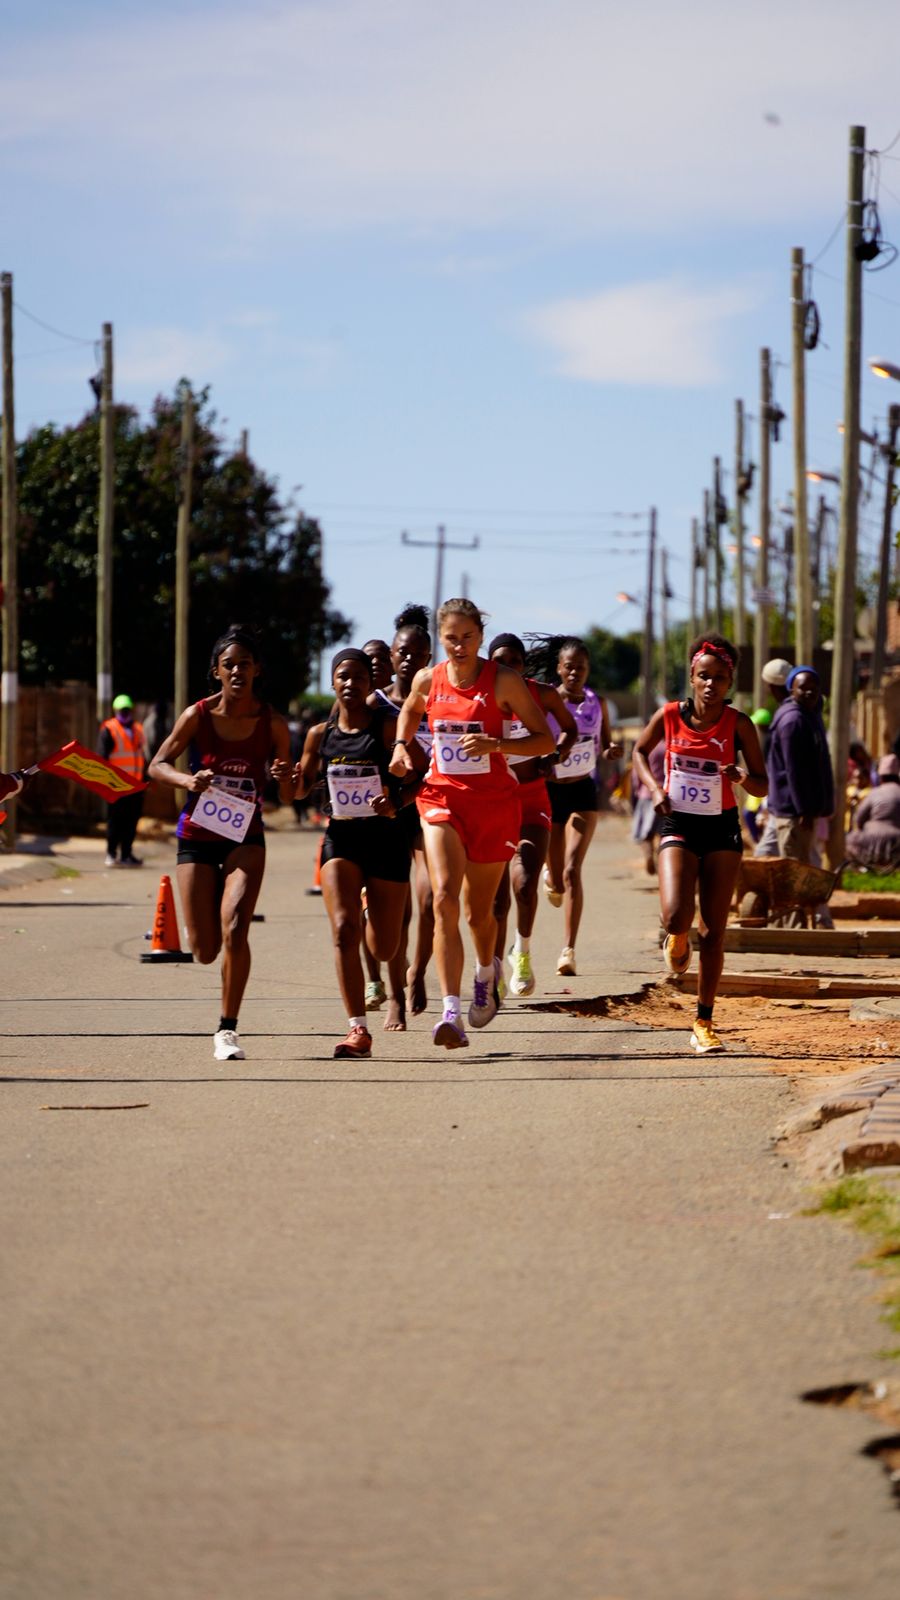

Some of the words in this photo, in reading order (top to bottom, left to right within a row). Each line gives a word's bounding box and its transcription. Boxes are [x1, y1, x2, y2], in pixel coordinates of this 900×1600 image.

[336, 789, 374, 806] 066
[680, 785, 711, 804] 193
[203, 800, 245, 828] 008
